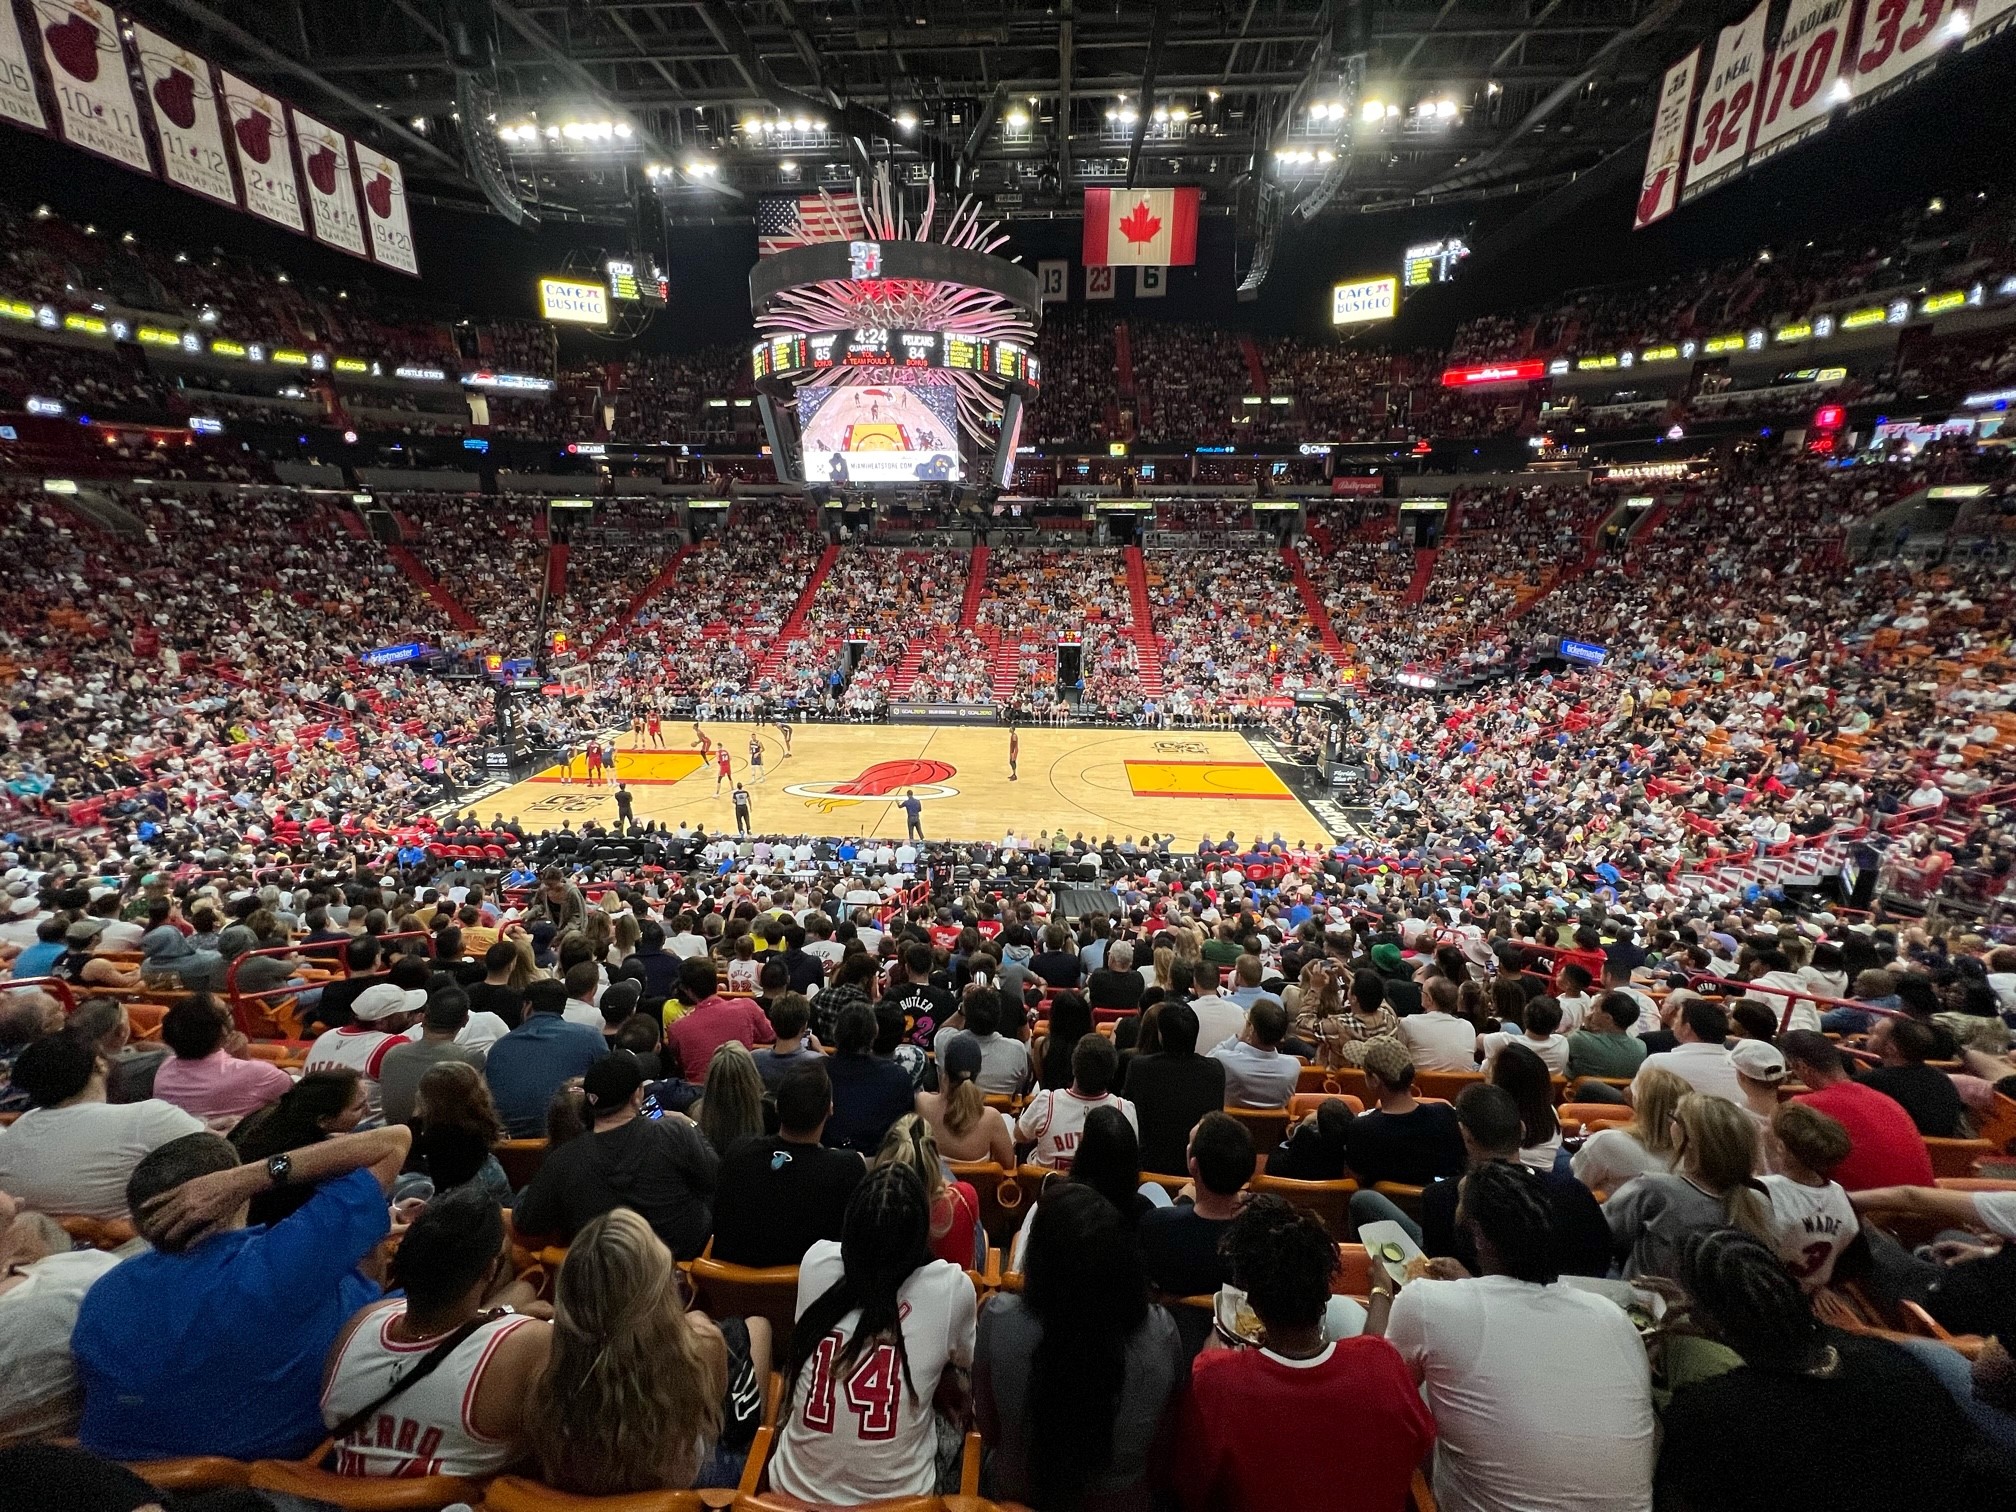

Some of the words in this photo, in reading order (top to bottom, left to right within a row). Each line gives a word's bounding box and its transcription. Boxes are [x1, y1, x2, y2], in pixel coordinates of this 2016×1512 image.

[1764, 26, 1839, 126] 10
[60, 87, 93, 119] 10
[111, 108, 137, 138] 11
[1692, 79, 1755, 166] 32
[163, 131, 187, 160] 11
[203, 149, 227, 175] 12
[277, 181, 297, 205] 13
[313, 198, 331, 220] 13
[373, 222, 387, 243] 19
[1043, 269, 1062, 294] 13
[1089, 267, 1112, 292] 23
[1143, 266, 1160, 289] 6
[546, 297, 603, 314] BUSTELO
[1337, 296, 1391, 314] BUSTELO
[855, 328, 888, 344] 4:24
[902, 335, 935, 347] PELICANS
[815, 347, 831, 360] 85
[849, 344, 878, 352] QUARTER
[908, 347, 926, 359] 84
[371, 649, 413, 663] icketmaster
[899, 996, 934, 1013] BUTLER
[1053, 1131, 1084, 1152] BUT
[1801, 1214, 1842, 1236] WADE
[803, 1329, 902, 1442] 14
